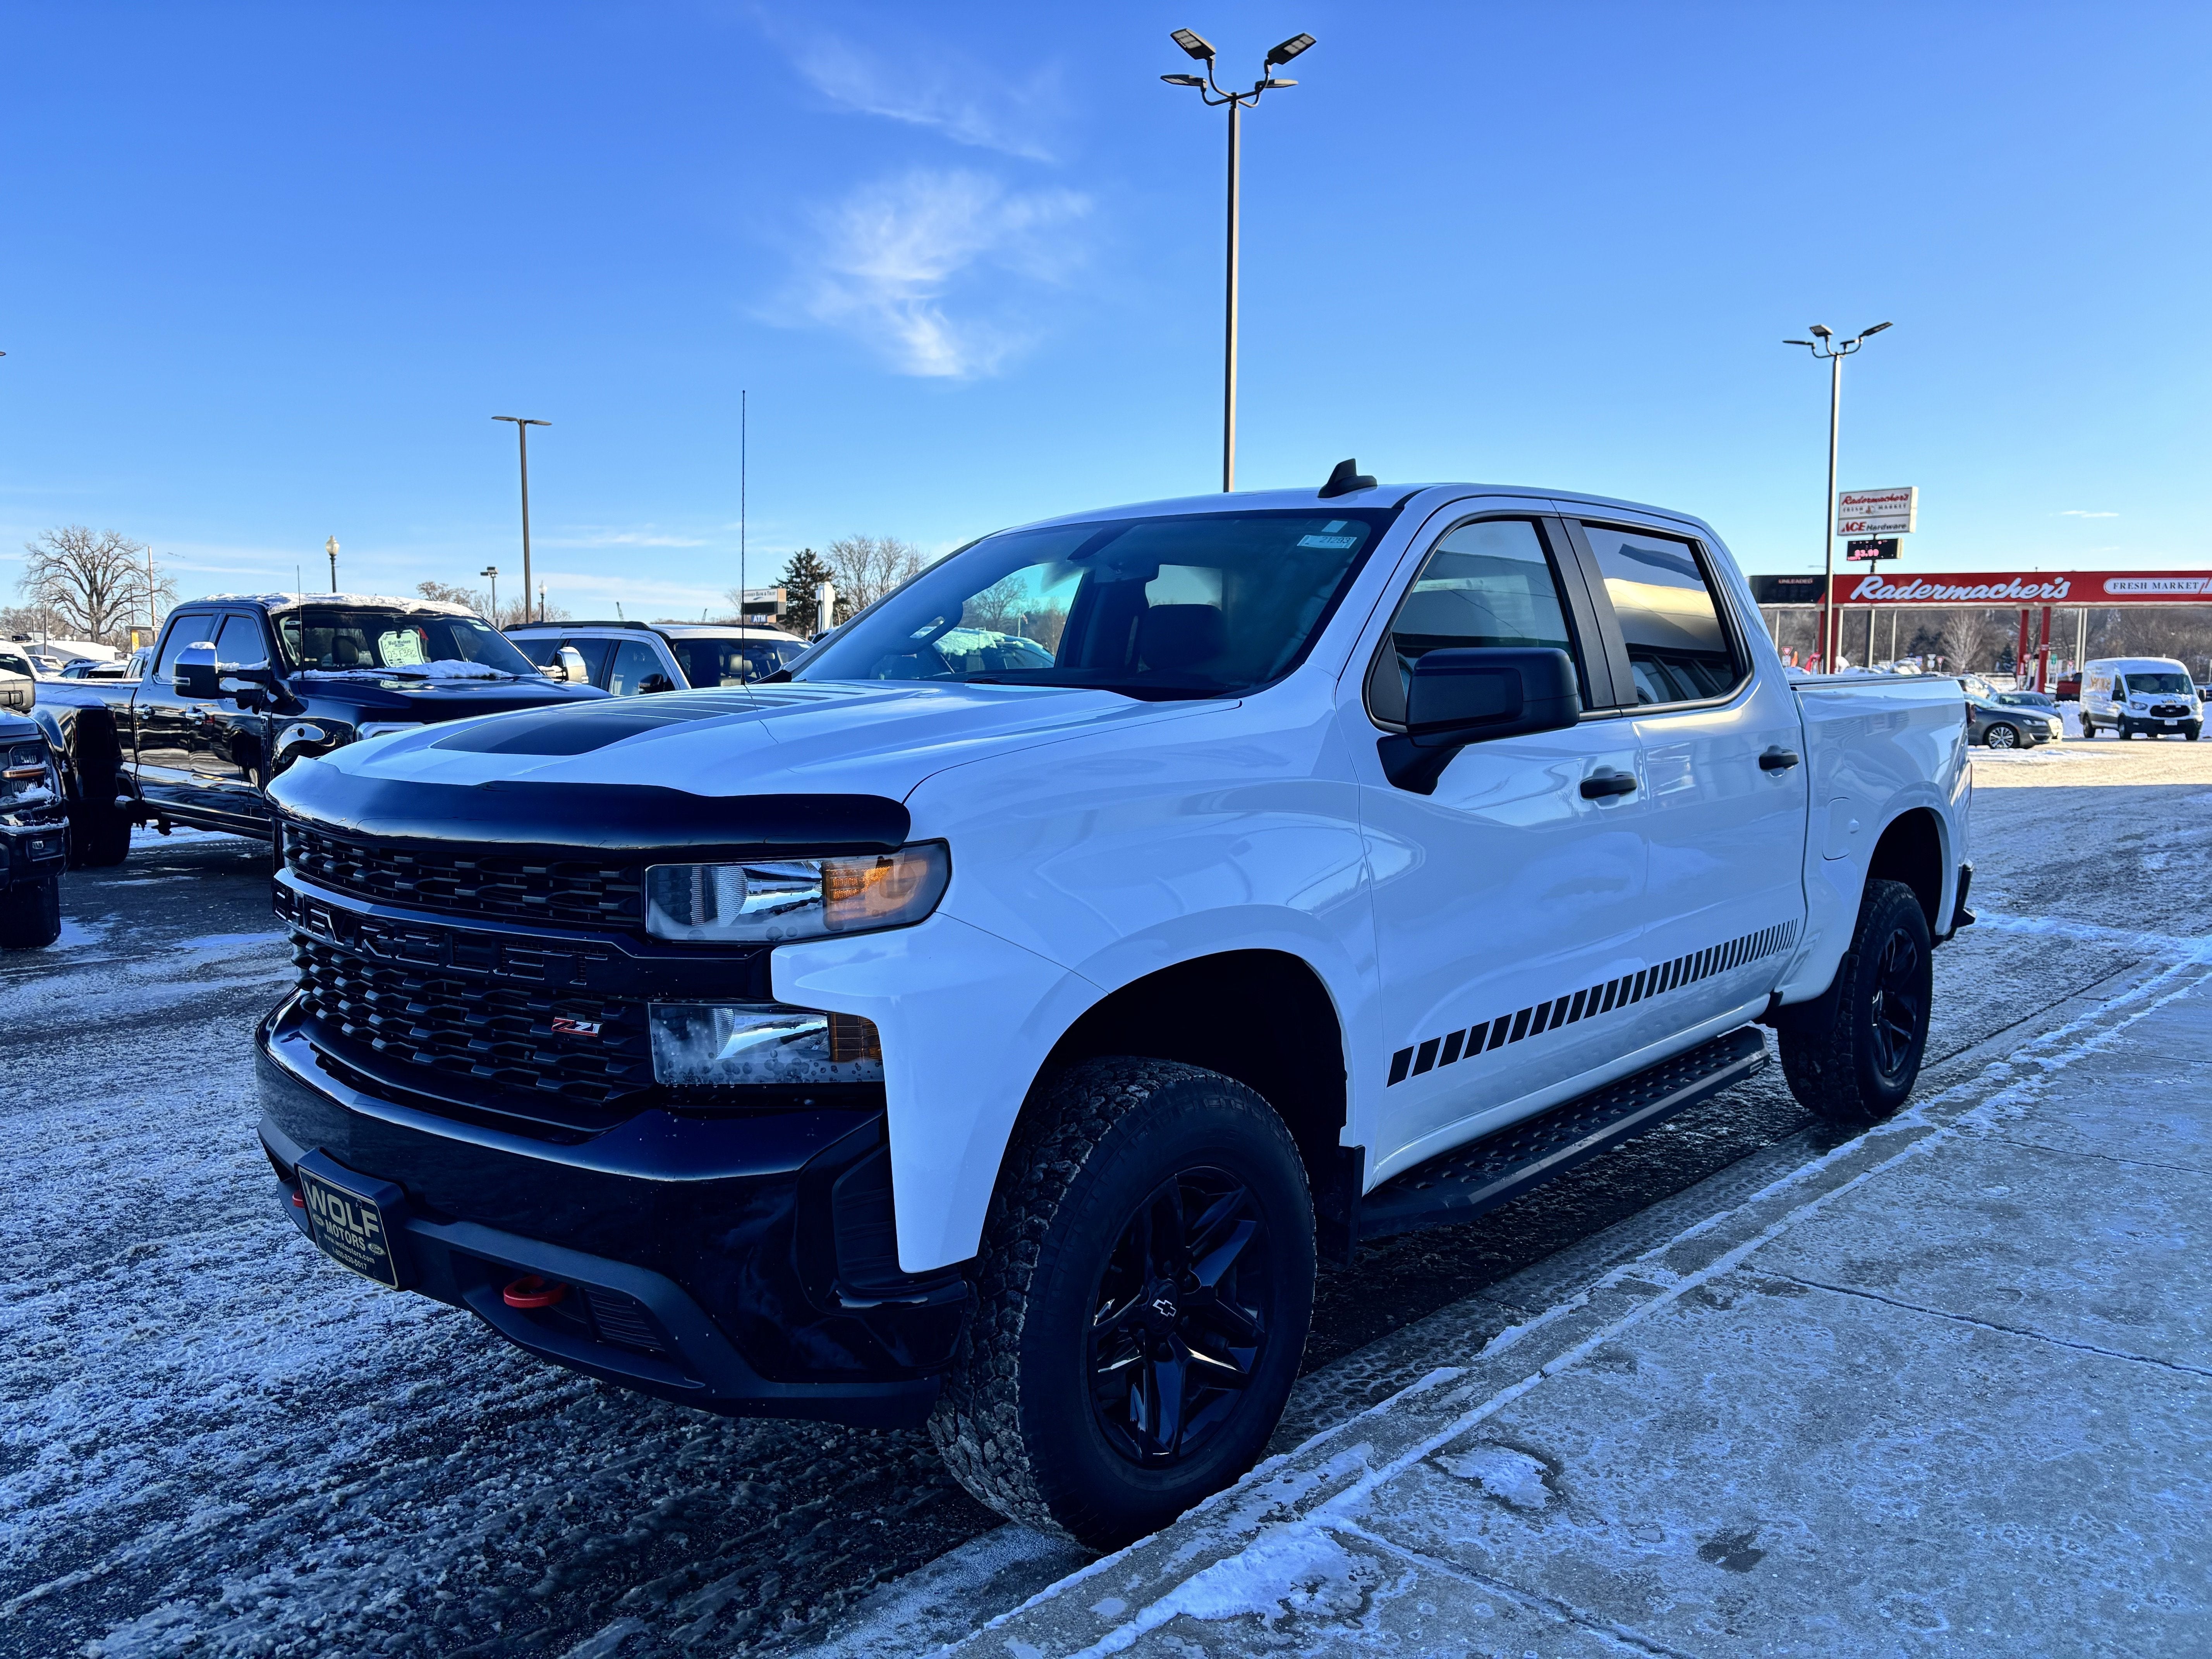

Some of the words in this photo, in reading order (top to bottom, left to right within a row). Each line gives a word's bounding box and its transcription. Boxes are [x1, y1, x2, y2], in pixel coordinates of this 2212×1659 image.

[1841, 522, 1867, 532] ACE
[1867, 523, 1907, 531] Hardware
[1850, 575, 2071, 601] Radermacher's
[551, 1017, 602, 1037] Z71
[304, 1181, 380, 1238] WOLF
[325, 1219, 366, 1251] MOTORS
